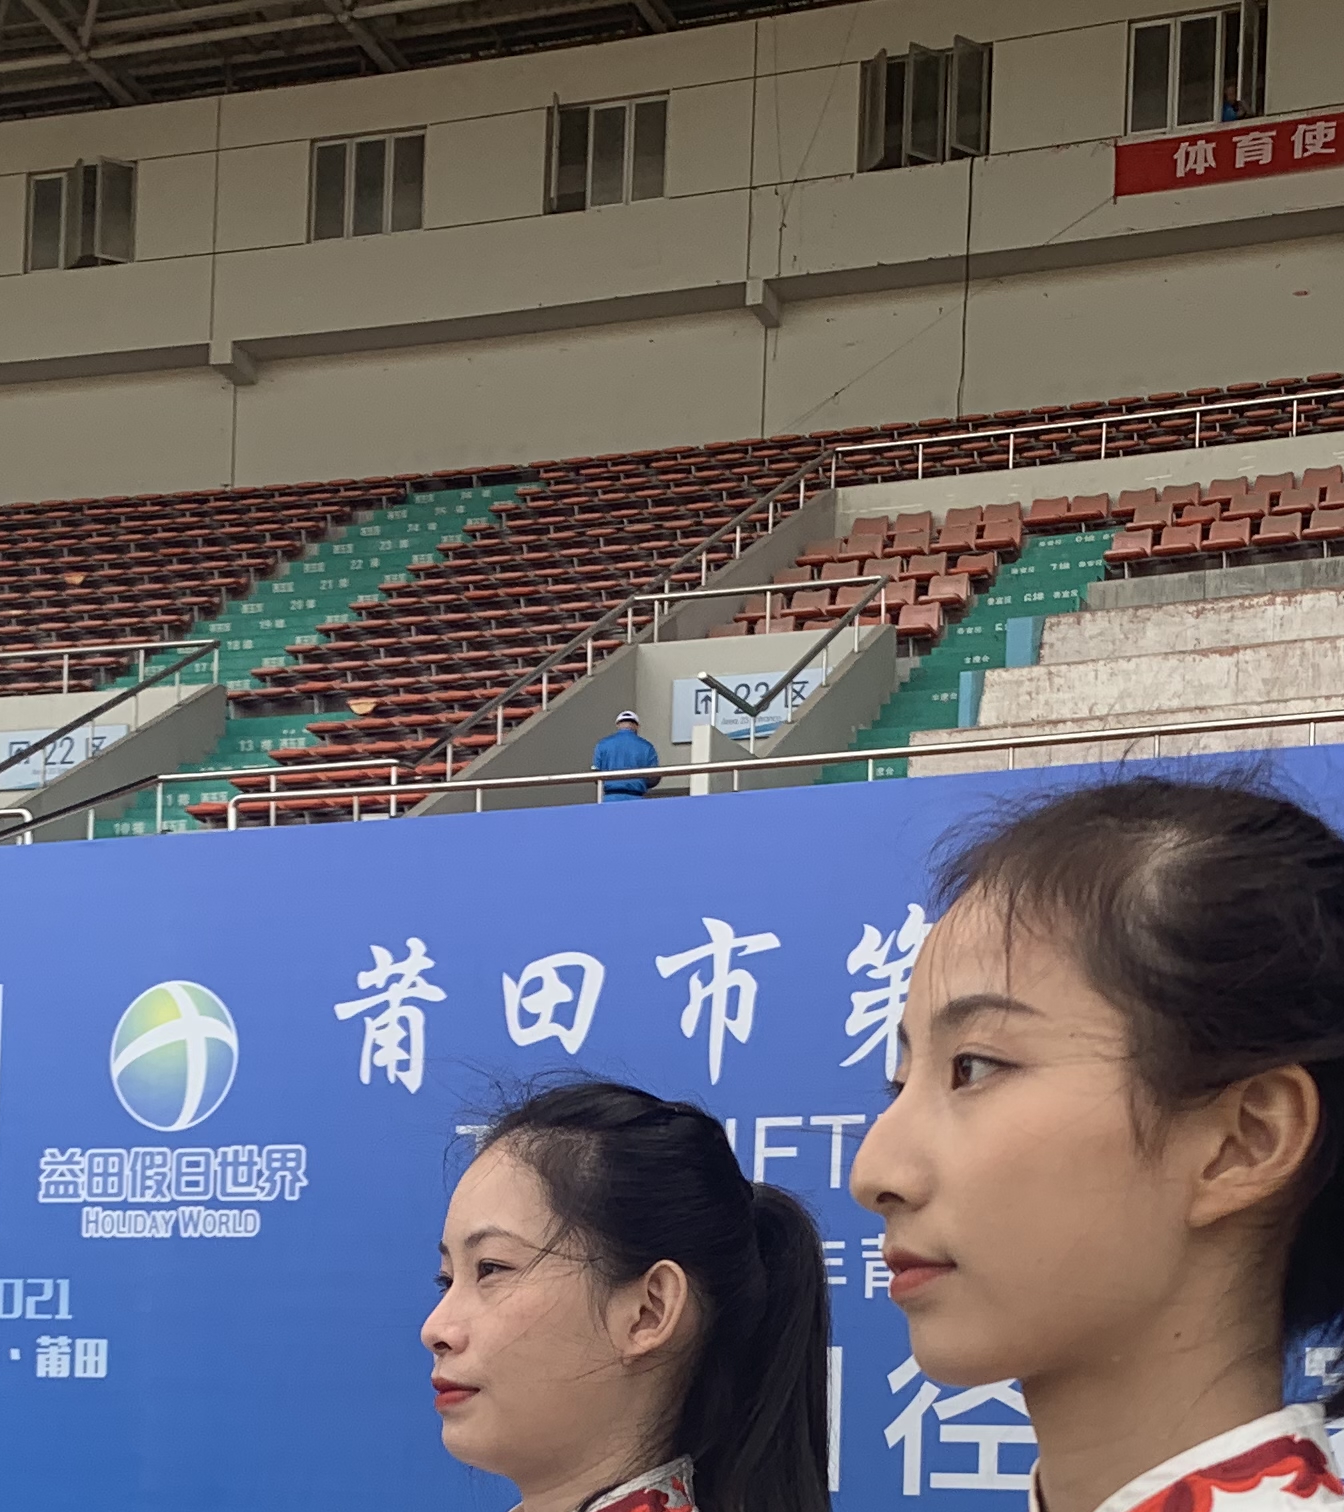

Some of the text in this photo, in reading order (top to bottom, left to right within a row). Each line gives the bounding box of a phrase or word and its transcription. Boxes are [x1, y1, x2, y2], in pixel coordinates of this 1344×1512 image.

[333, 902, 938, 1094] 莆田市第
[39, 1145, 309, 1204] 益田假日世界
